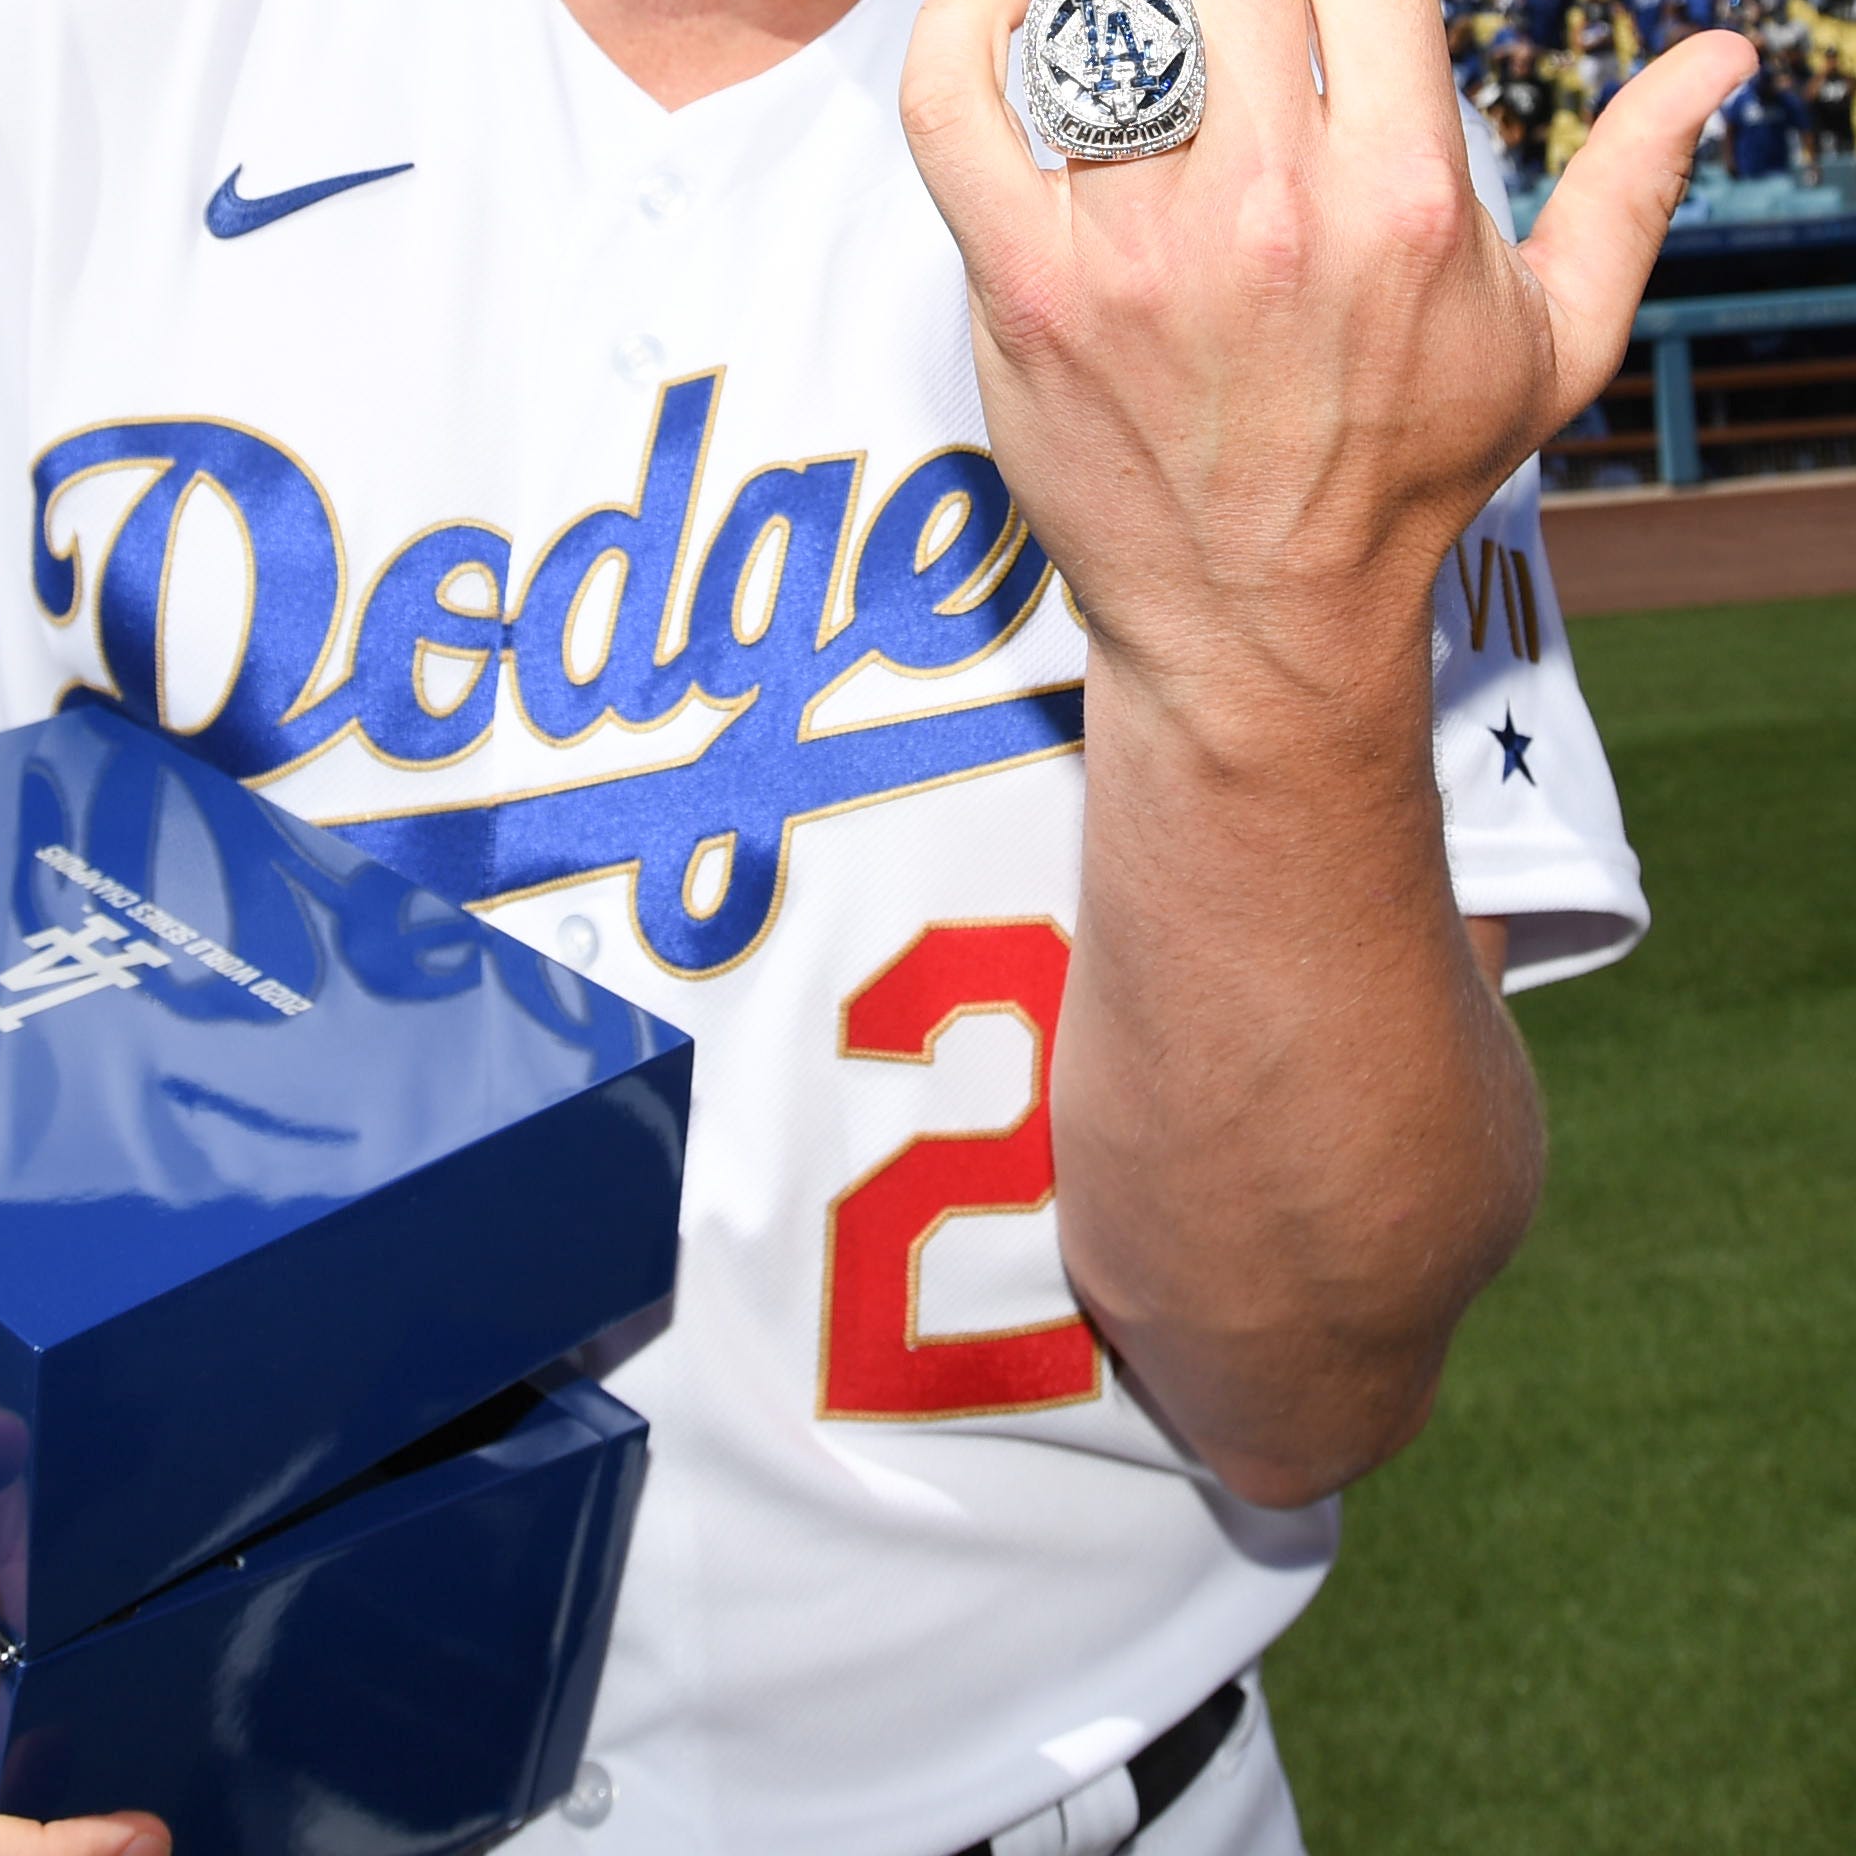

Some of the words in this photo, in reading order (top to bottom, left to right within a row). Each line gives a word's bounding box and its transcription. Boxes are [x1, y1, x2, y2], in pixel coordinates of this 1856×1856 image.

[1060, 101, 1192, 147] CHAMPIONS
[30, 365, 1087, 983] Dodge
[34, 843, 142, 910] CHAMPIONS
[126, 901, 200, 946] SERIES
[183, 941, 263, 988] WORLD
[247, 977, 316, 1018] 2020
